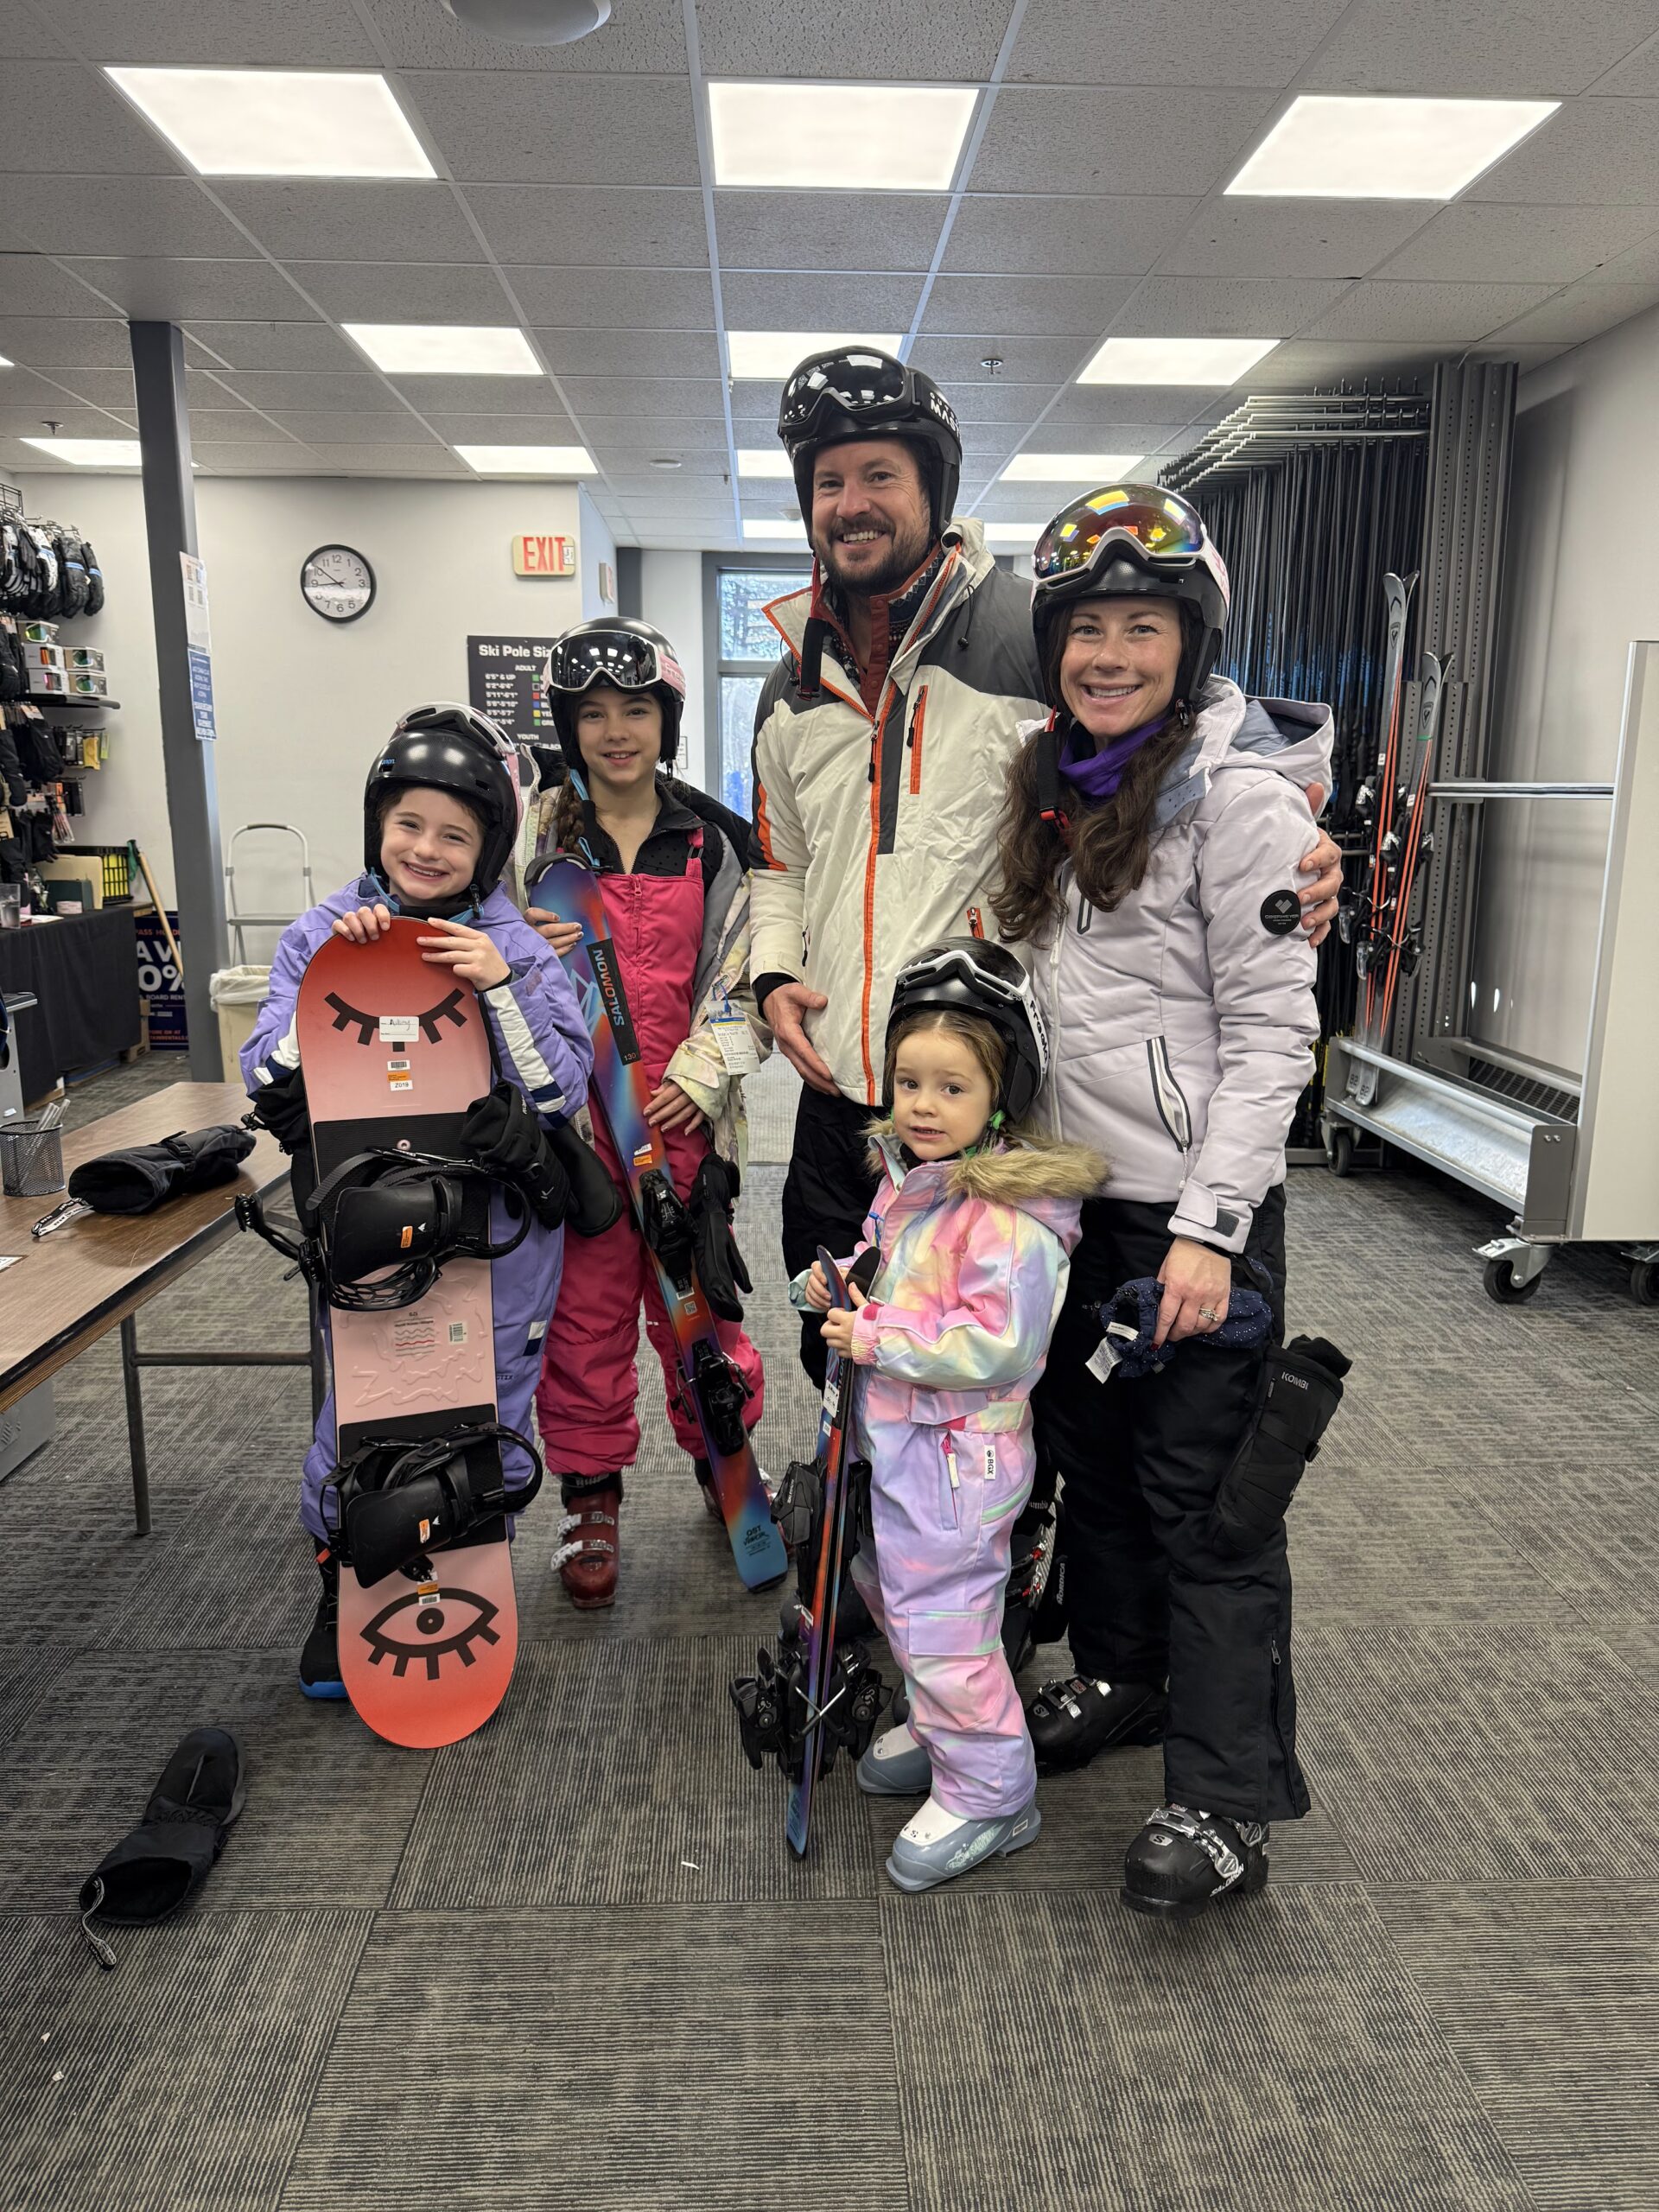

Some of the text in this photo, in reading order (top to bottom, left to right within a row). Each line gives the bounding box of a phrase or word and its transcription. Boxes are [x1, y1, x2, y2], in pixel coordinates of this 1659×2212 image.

[332, 554, 342, 563] 12
[523, 537, 566, 571] EXIT
[322, 558, 329, 568] 11
[347, 558, 352, 568] 1
[354, 567, 362, 577] 2
[311, 578, 319, 588] 9
[358, 578, 366, 588] 3
[325, 600, 331, 609] 7
[336, 603, 345, 613] 6
[347, 600, 356, 609] 5
[479, 645, 500, 657] Ski
[502, 645, 531, 657] Pole
[593, 948, 625, 1027] SALOMON
[623, 1052, 637, 1062] 130
[1281, 1370, 1309, 1390] KOMBI
